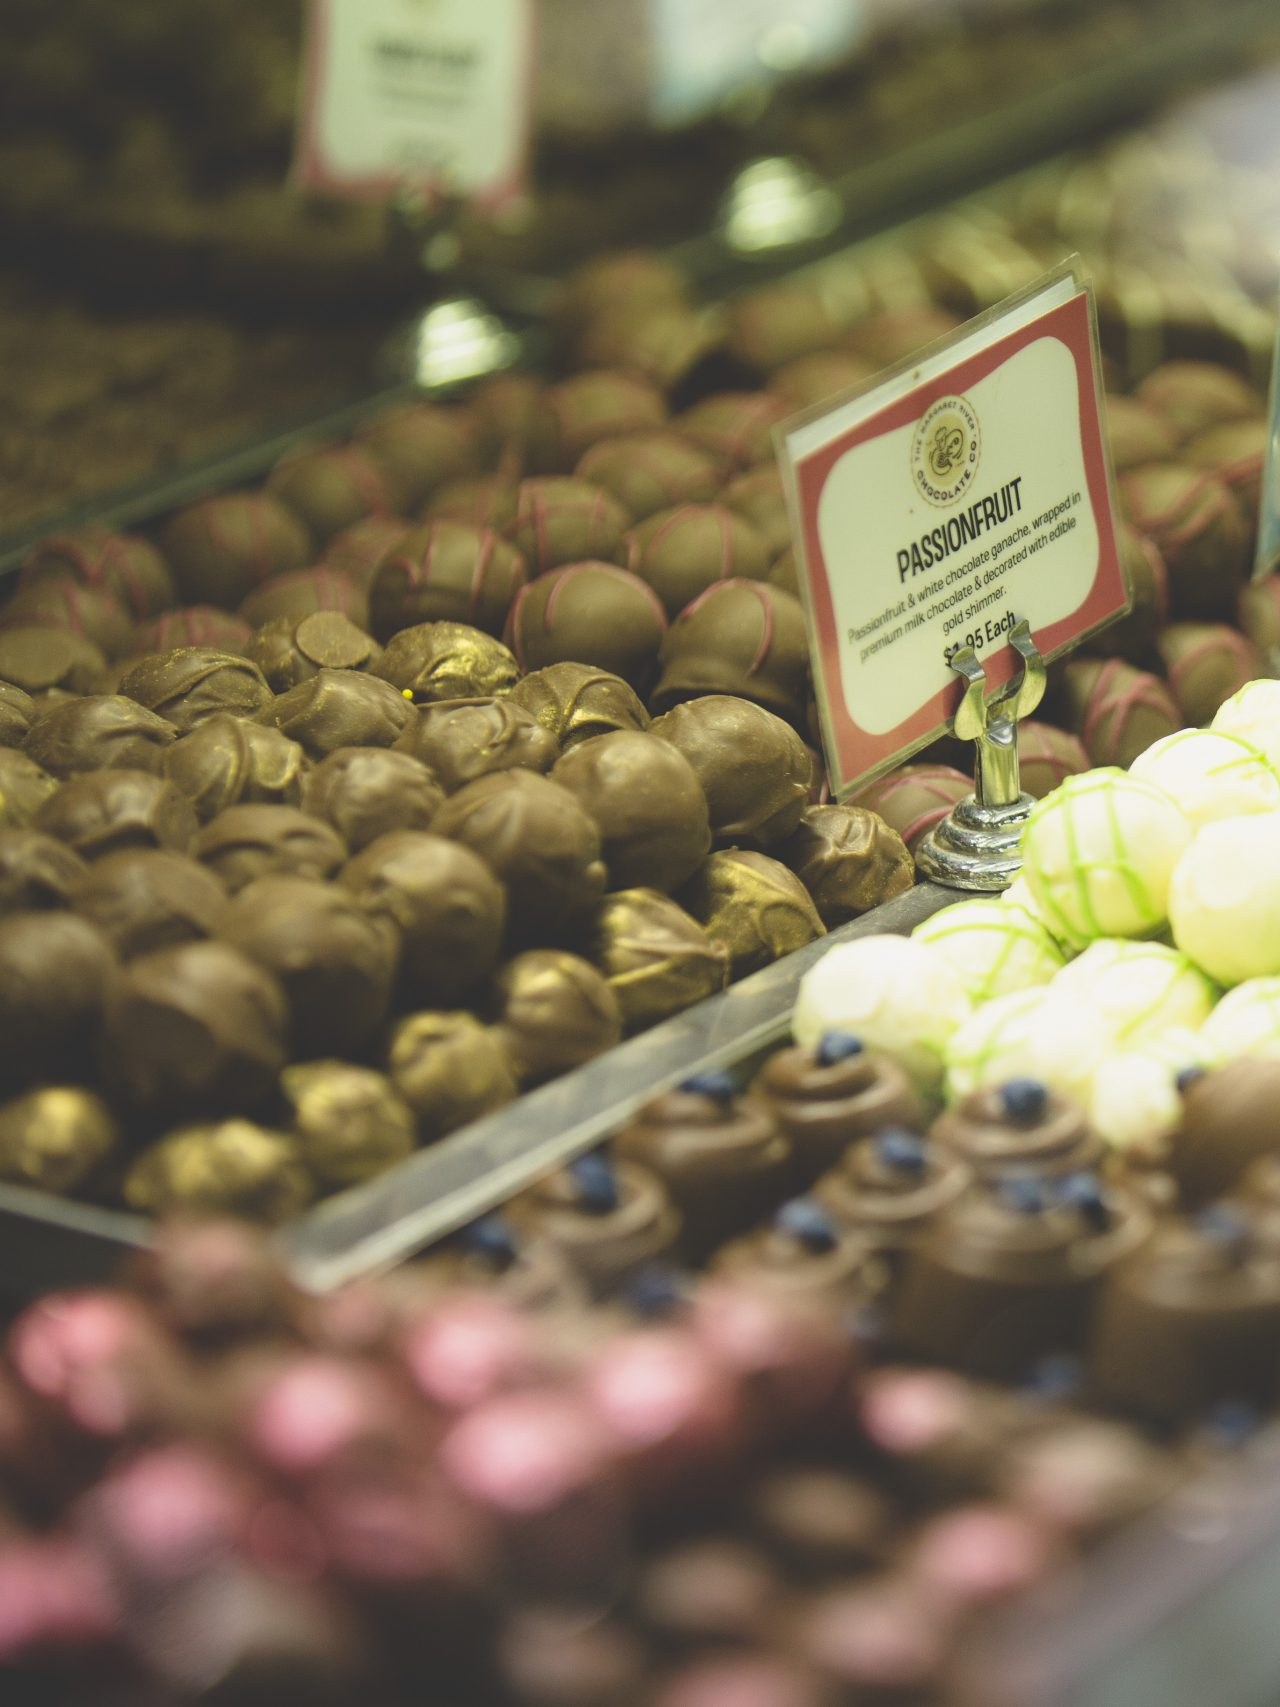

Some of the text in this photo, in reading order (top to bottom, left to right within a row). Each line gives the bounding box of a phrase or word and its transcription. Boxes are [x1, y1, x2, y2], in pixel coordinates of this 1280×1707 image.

[917, 469, 971, 501] CHOCOLATE
[847, 492, 1081, 645] Passionfruit & white chocolate ganache, wrapped in
[896, 477, 1022, 583] PASSIONFRUIT
[860, 517, 1077, 664] premium milk chocolate & decorated with edible
[943, 586, 1007, 636] gold shimmer.
[944, 610, 1016, 668] $95 Each
